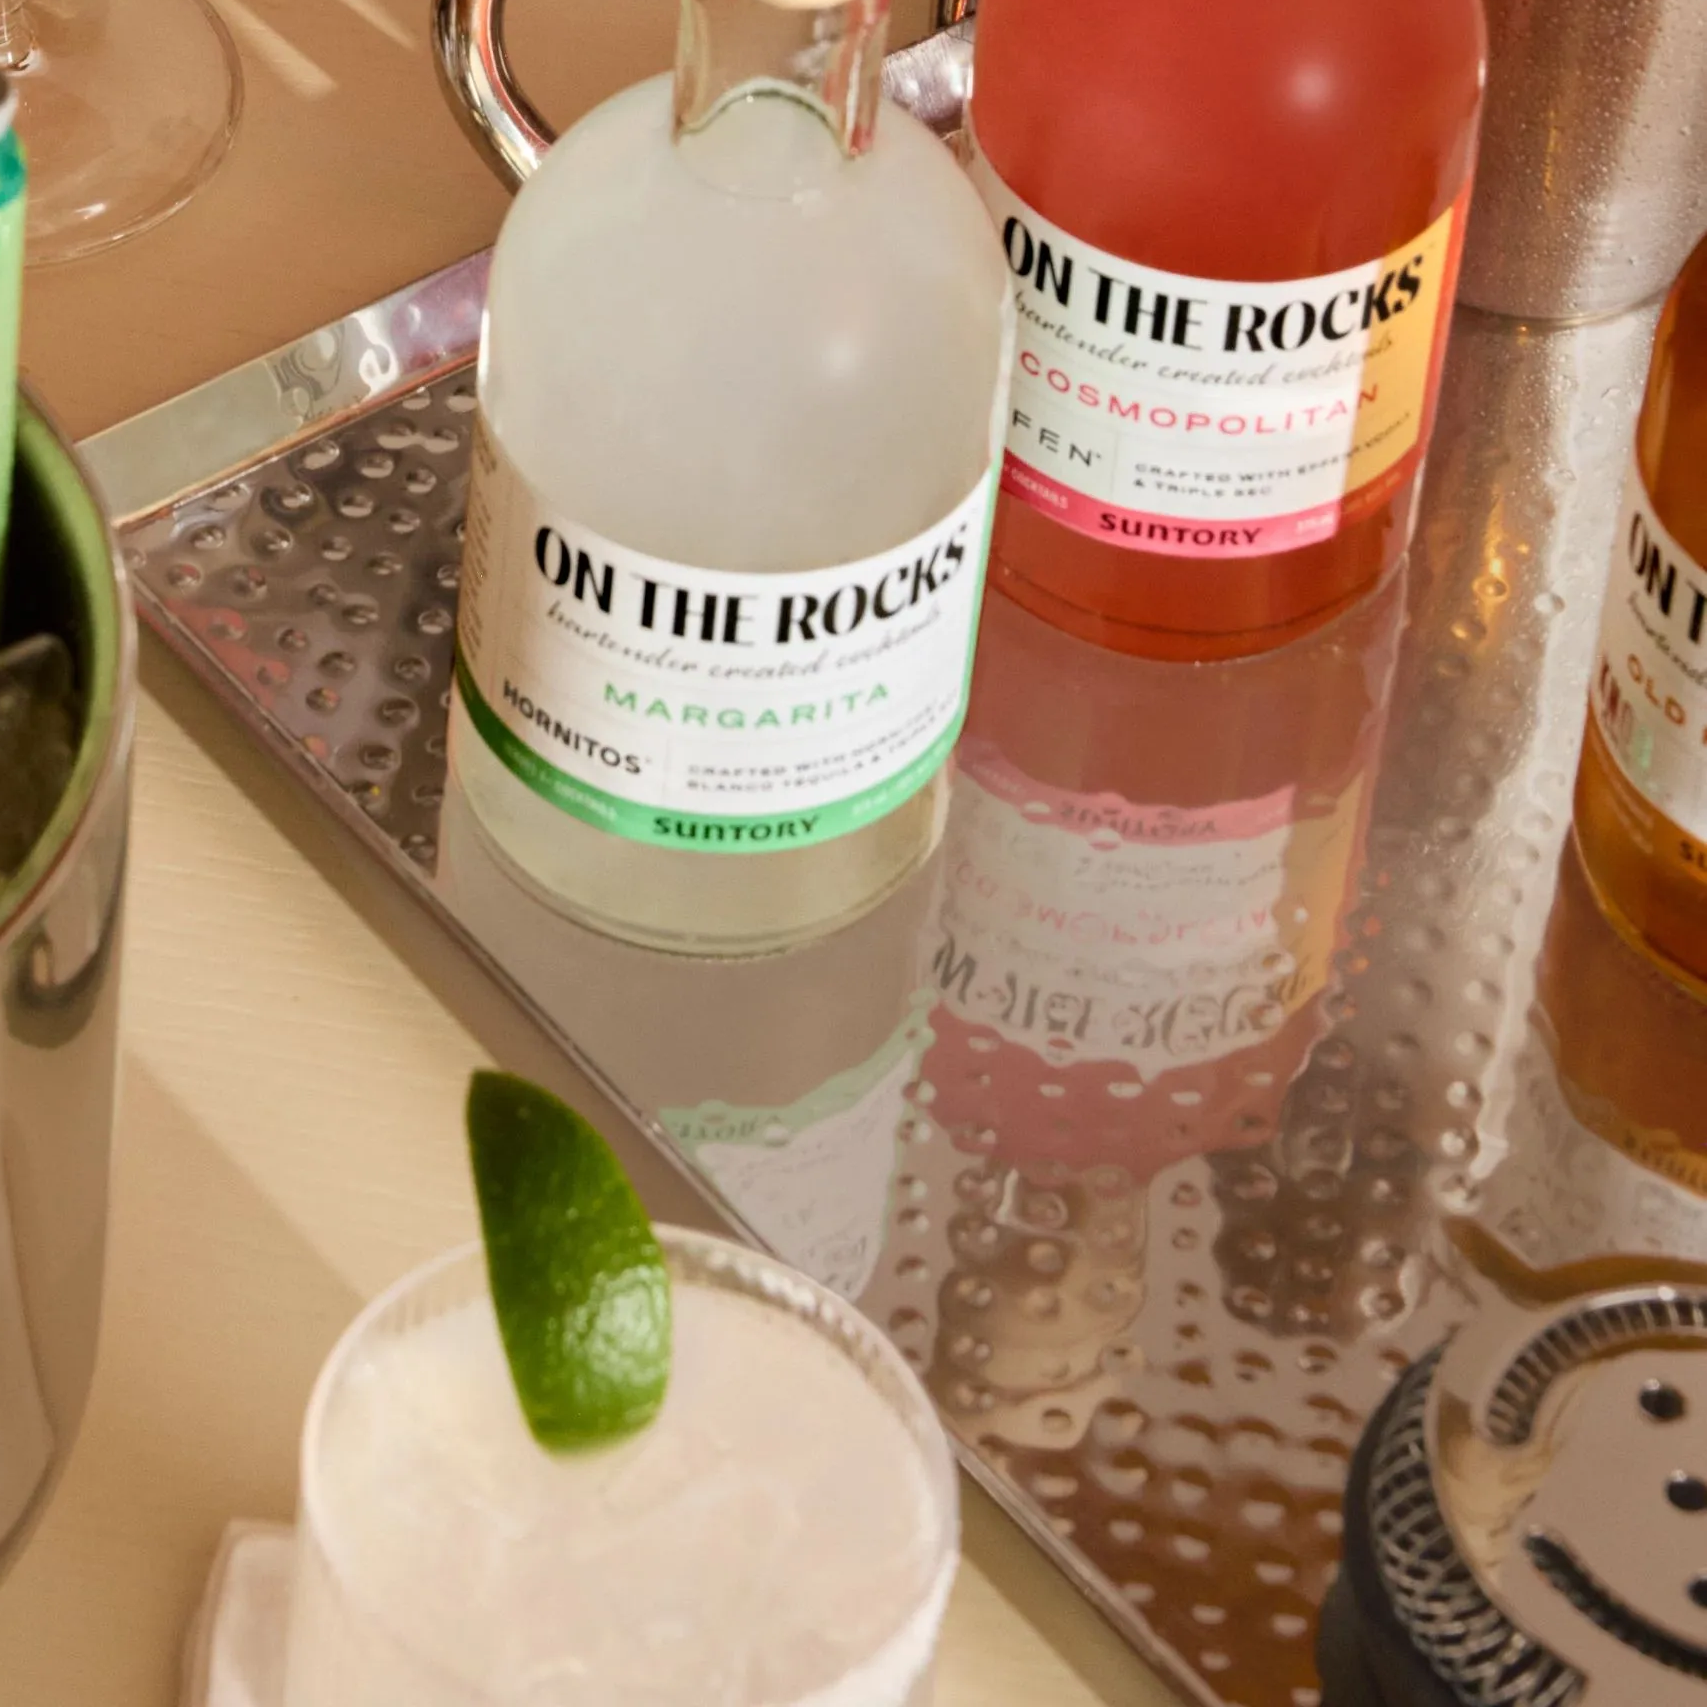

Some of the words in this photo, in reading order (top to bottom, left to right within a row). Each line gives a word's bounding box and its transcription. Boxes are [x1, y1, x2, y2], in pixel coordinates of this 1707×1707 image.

[1003, 216, 1073, 309] ON
[1088, 264, 1209, 352] THE
[1222, 253, 1425, 355] ROCKS
[1014, 291, 1149, 372] bartender
[1157, 361, 1277, 388] created
[1019, 350, 1380, 438] COSMOPOLITAN
[1012, 408, 1094, 469] FEN
[1134, 462, 1232, 484] CRAFTED
[1239, 467, 1292, 483] WITH
[1098, 511, 1263, 547] SUNTORY
[1627, 511, 1677, 617] ON
[535, 525, 617, 616] ON
[631, 572, 760, 648] THE
[774, 521, 969, 644] ROCKS
[546, 599, 698, 673] bartender
[603, 680, 890, 730] MARGARITA
[1626, 653, 1687, 727] OLD
[653, 814, 821, 843] SUNTORY
